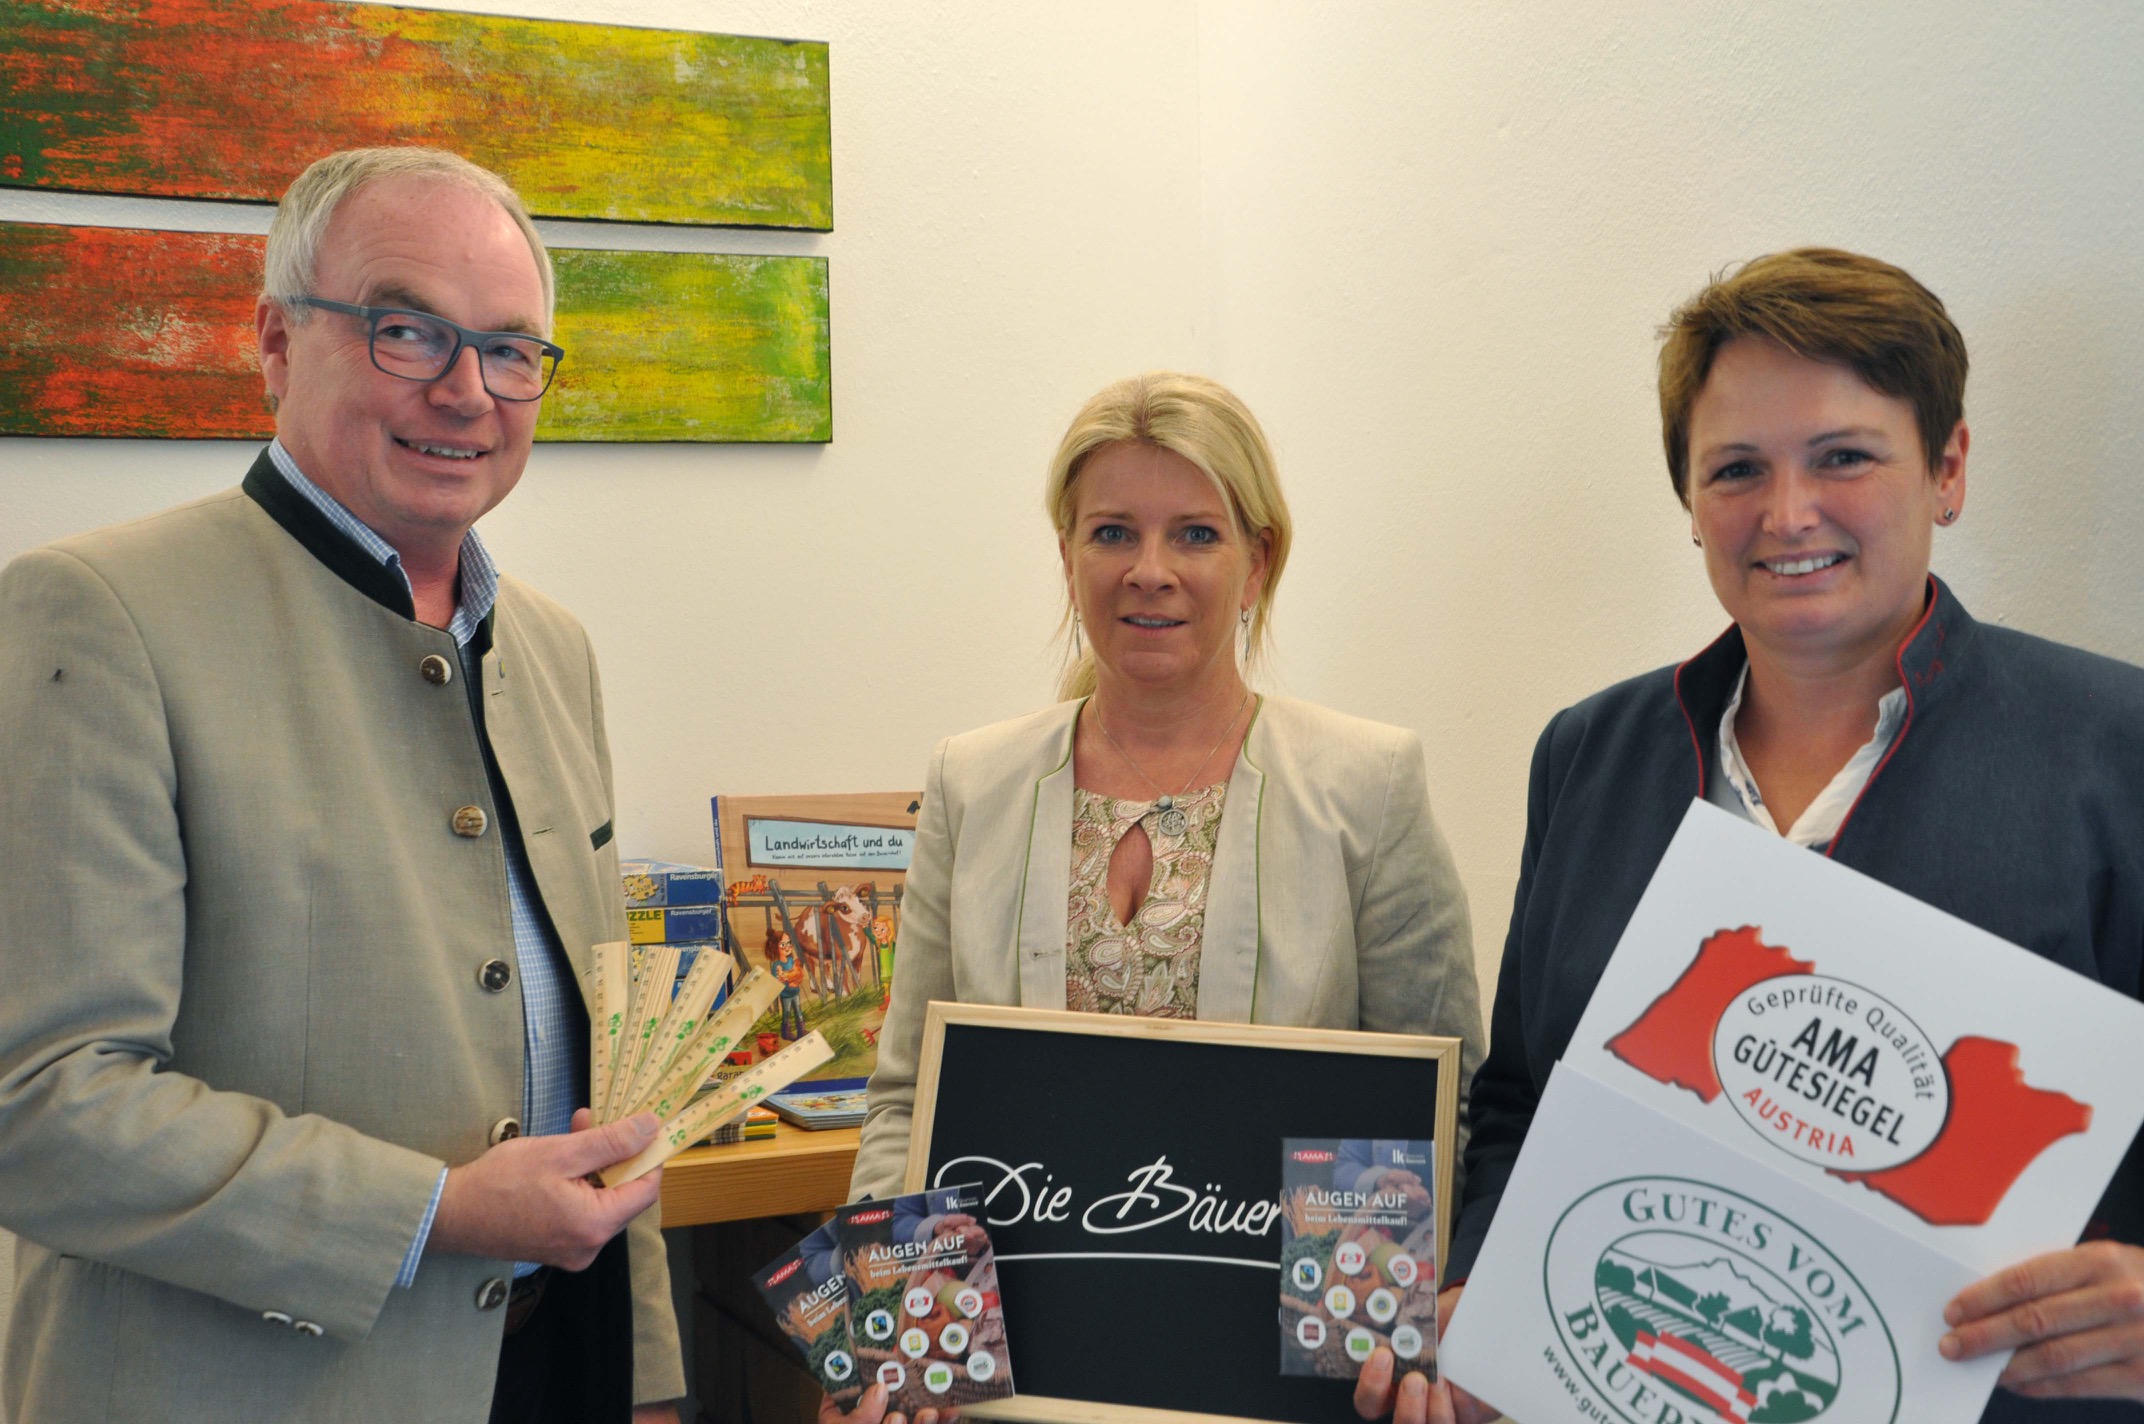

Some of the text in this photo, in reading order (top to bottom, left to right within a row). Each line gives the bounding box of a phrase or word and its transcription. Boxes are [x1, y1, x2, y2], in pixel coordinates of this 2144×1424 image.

[670, 873, 718, 881] Ravensburger
[766, 835, 903, 851] Landwirtschaft und du
[670, 908, 712, 916] Ravensburger
[1747, 984, 1935, 1100] Geprüfte Qualität
[1790, 1015, 1880, 1088] AMA
[1734, 1034, 1905, 1147] GÜTESIEGEL
[1743, 1086, 1856, 1158] AUSTRIA
[933, 1154, 1282, 1237] Die Bäuer
[1305, 1190, 1408, 1208] AUGEN AUF
[1305, 1213, 1408, 1226] beim Lebensmittelkauf!
[868, 1234, 965, 1263] AUGEN AUF
[870, 1254, 968, 1279] beim Lebensmittelkauf!
[1622, 1187, 1867, 1339] GUTES VOM
[1543, 1346, 1614, 1424] www.gut
[1564, 1301, 1703, 1424] BAUER
